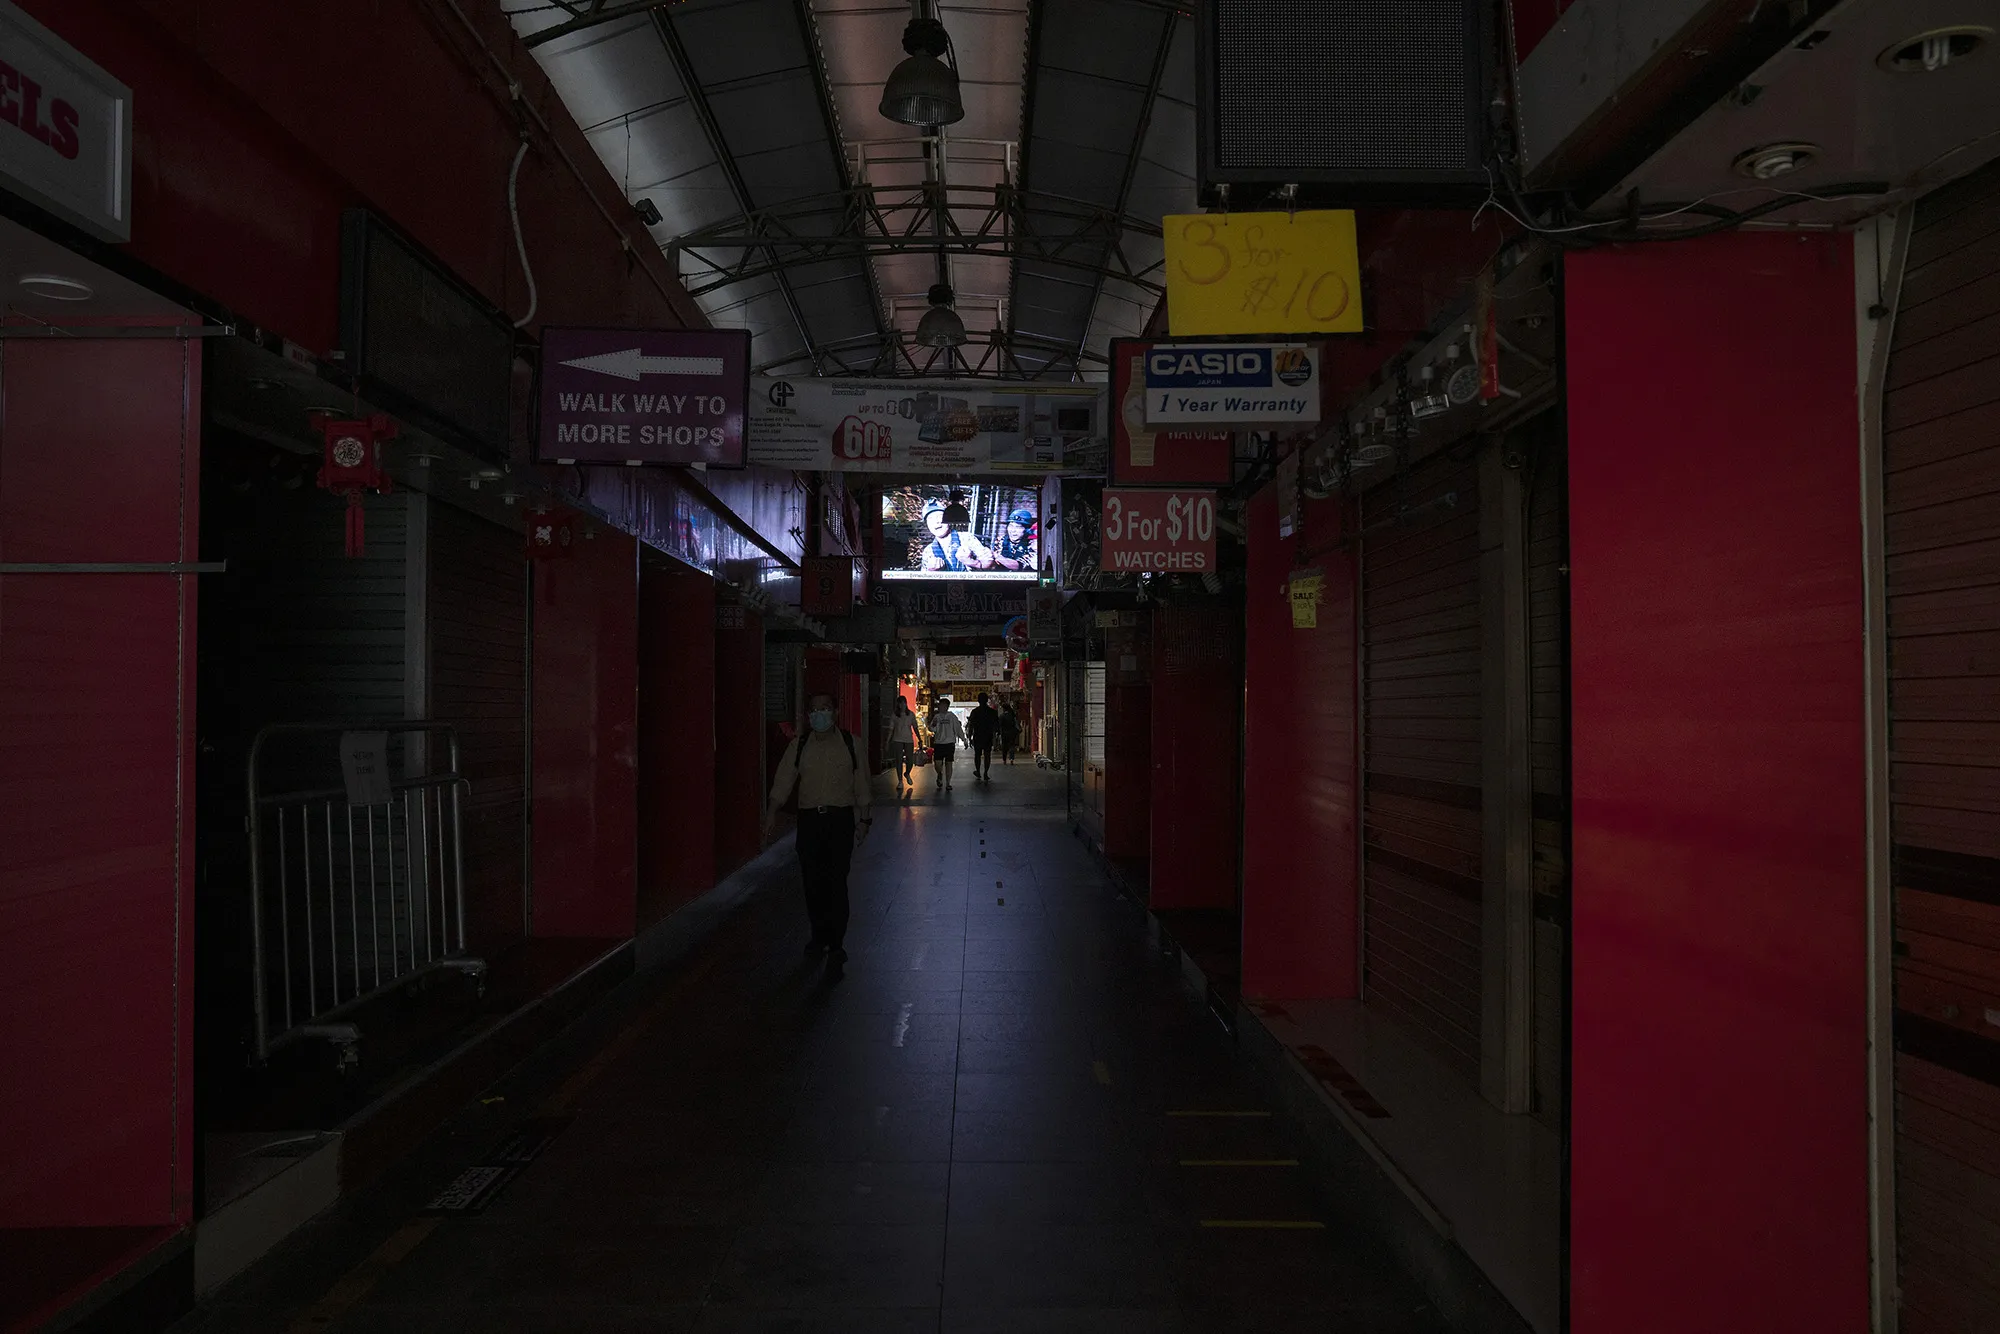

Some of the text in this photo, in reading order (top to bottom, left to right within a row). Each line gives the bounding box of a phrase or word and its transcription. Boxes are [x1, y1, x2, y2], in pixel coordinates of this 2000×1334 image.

[1179, 220, 1292, 285] 3 for
[1240, 268, 1349, 322] $10
[1150, 353, 1261, 376] CASIO
[559, 393, 726, 415] WALK WAY TO
[859, 405, 884, 413] UP TO
[1160, 394, 1307, 414] 1 Year Warranty
[558, 423, 725, 447] MORE SHOPS
[880, 447, 892, 458] OFF
[1107, 495, 1213, 546] 3 For $10
[1114, 552, 1205, 568] WATCHES
[1293, 592, 1314, 600] SALE
